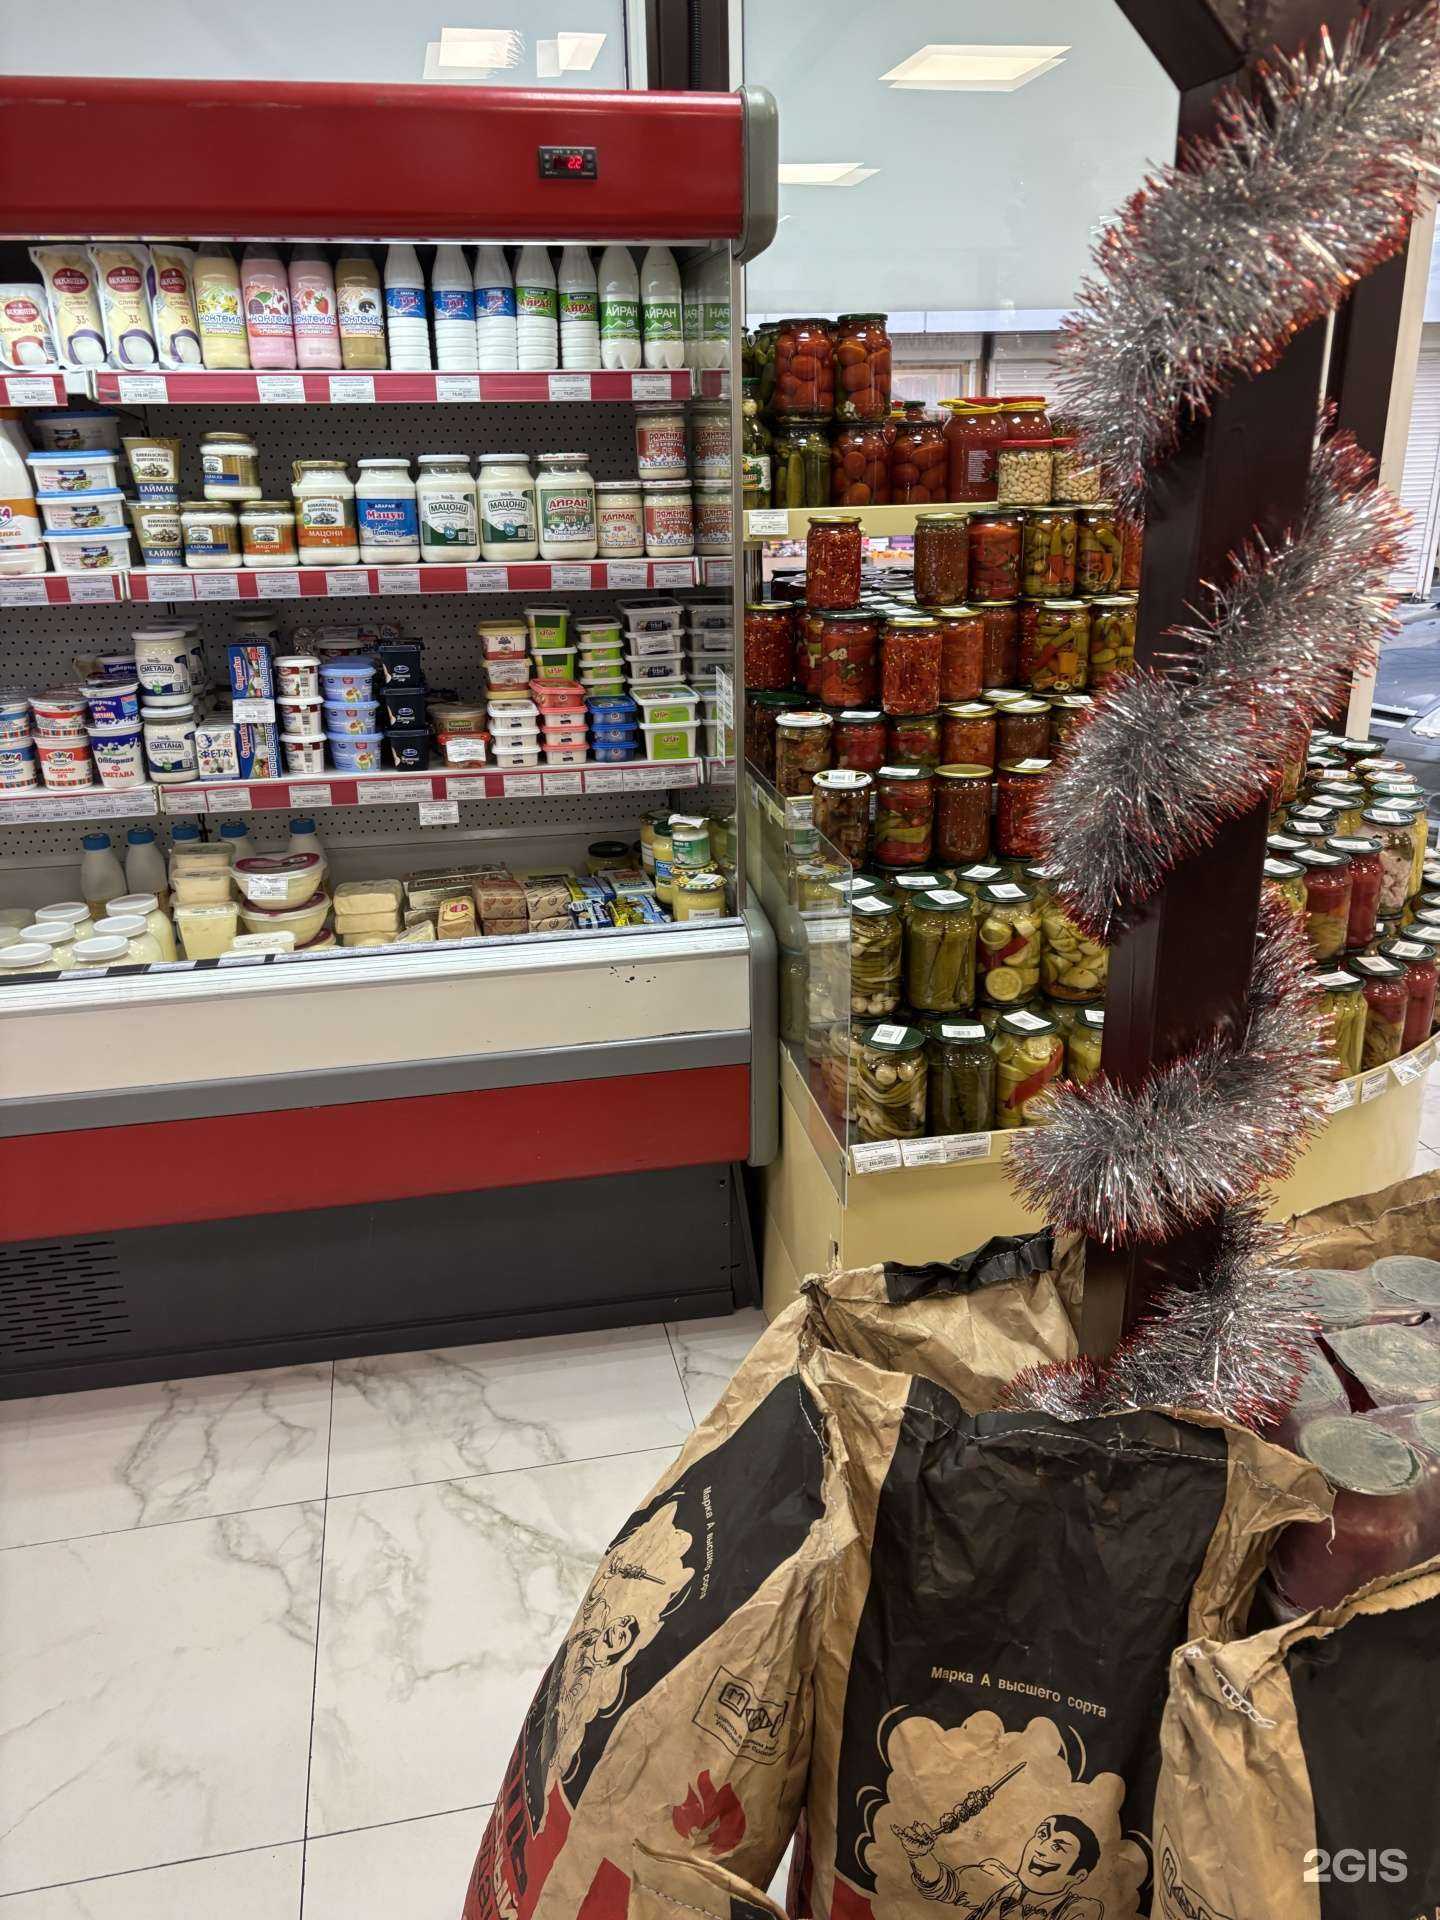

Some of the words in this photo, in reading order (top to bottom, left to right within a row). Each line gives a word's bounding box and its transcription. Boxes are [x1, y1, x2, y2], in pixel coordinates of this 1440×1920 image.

[606, 304, 638, 317] АЙРАН
[645, 306, 677, 319] АЙРАН
[429, 504, 467, 513] МАЦОНИ
[490, 501, 528, 511] МАЦОНИ
[549, 498, 588, 510] АЙРАН
[308, 530, 344, 538] МАЦОНИ
[931, 1666, 974, 1684] Марка
[980, 1672, 991, 1687] А
[998, 1678, 1061, 1703] высшего
[1067, 1695, 1107, 1719] сорта
